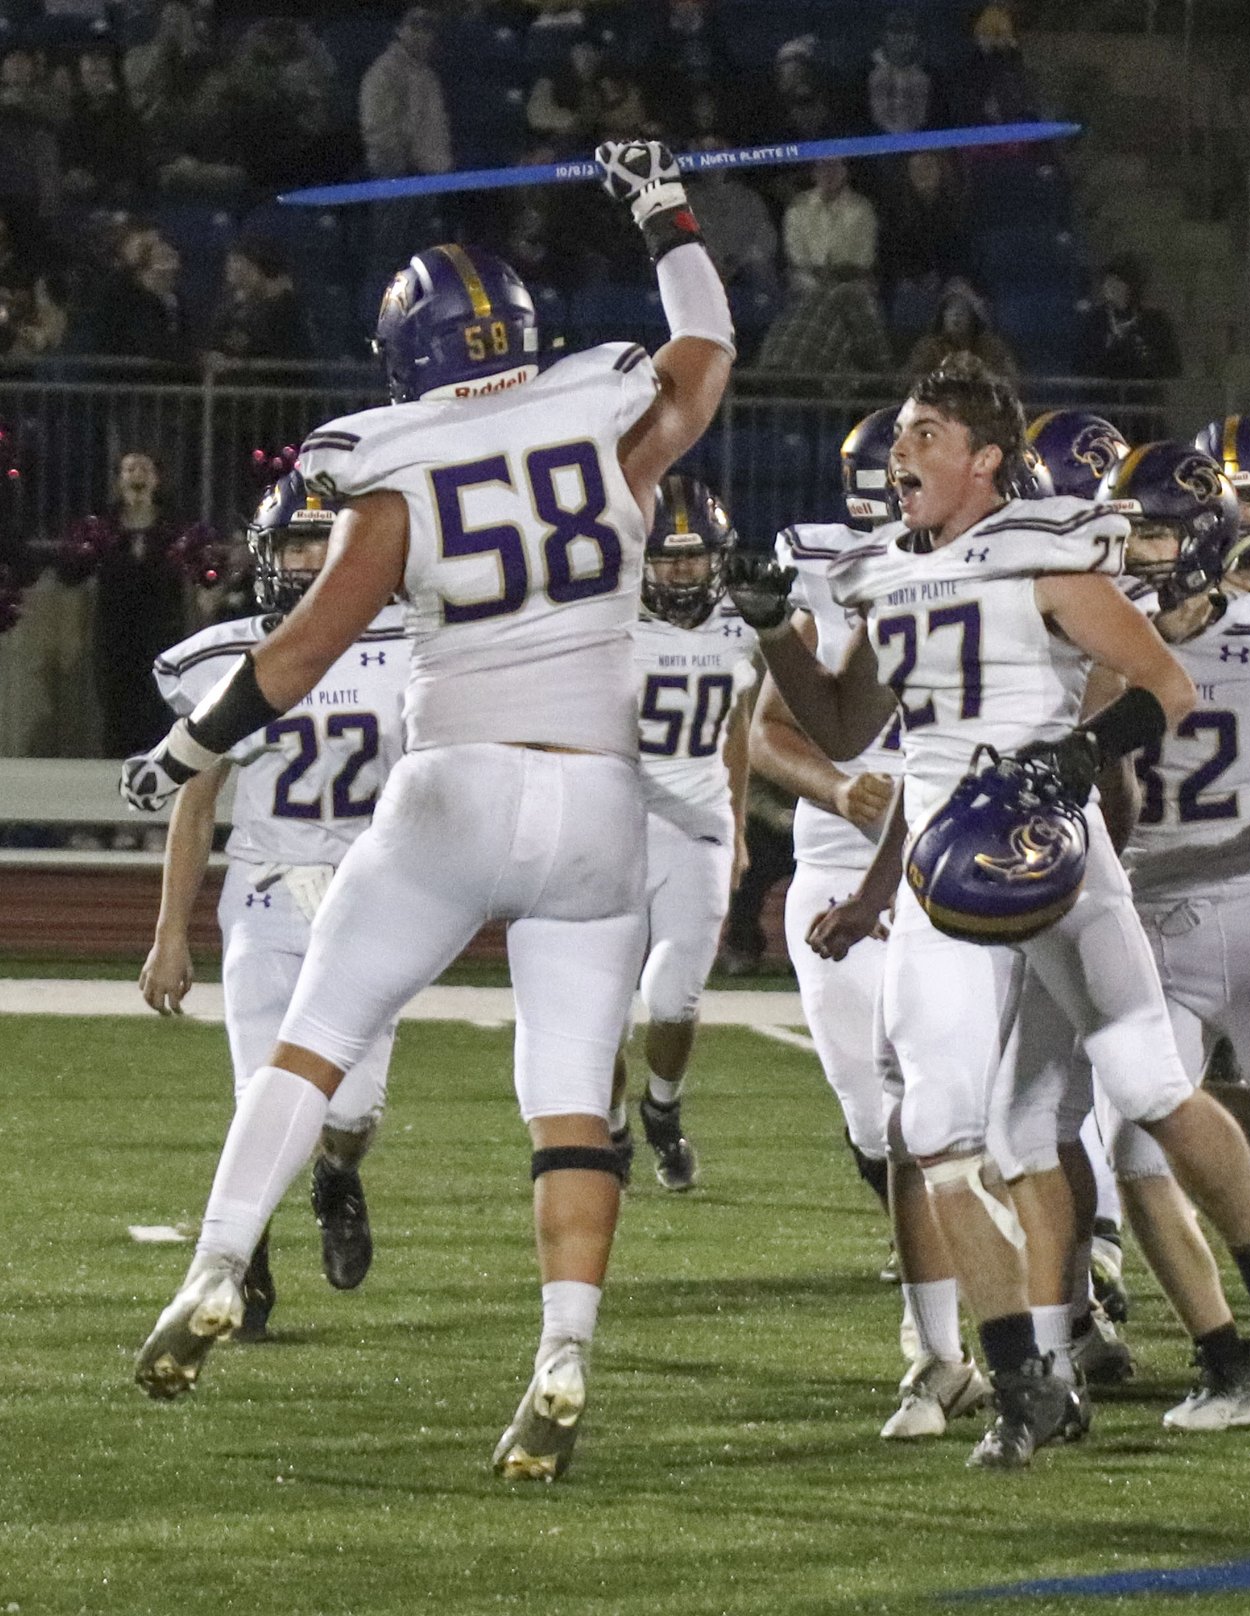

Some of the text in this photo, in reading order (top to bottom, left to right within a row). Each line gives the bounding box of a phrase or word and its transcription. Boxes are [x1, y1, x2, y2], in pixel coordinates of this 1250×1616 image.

[700, 153, 737, 166] NORTH
[740, 147, 784, 161] PLATTE
[786, 144, 799, 157] 14
[465, 321, 509, 360] 58
[455, 371, 527, 398] Riddell
[426, 436, 624, 627] 58
[888, 581, 957, 606] NORTH PLATTE
[658, 655, 721, 667] NORTH PLATTE
[878, 600, 984, 732] 27
[319, 689, 359, 705] PLATTE
[638, 673, 734, 757] 50
[264, 711, 379, 820] 22
